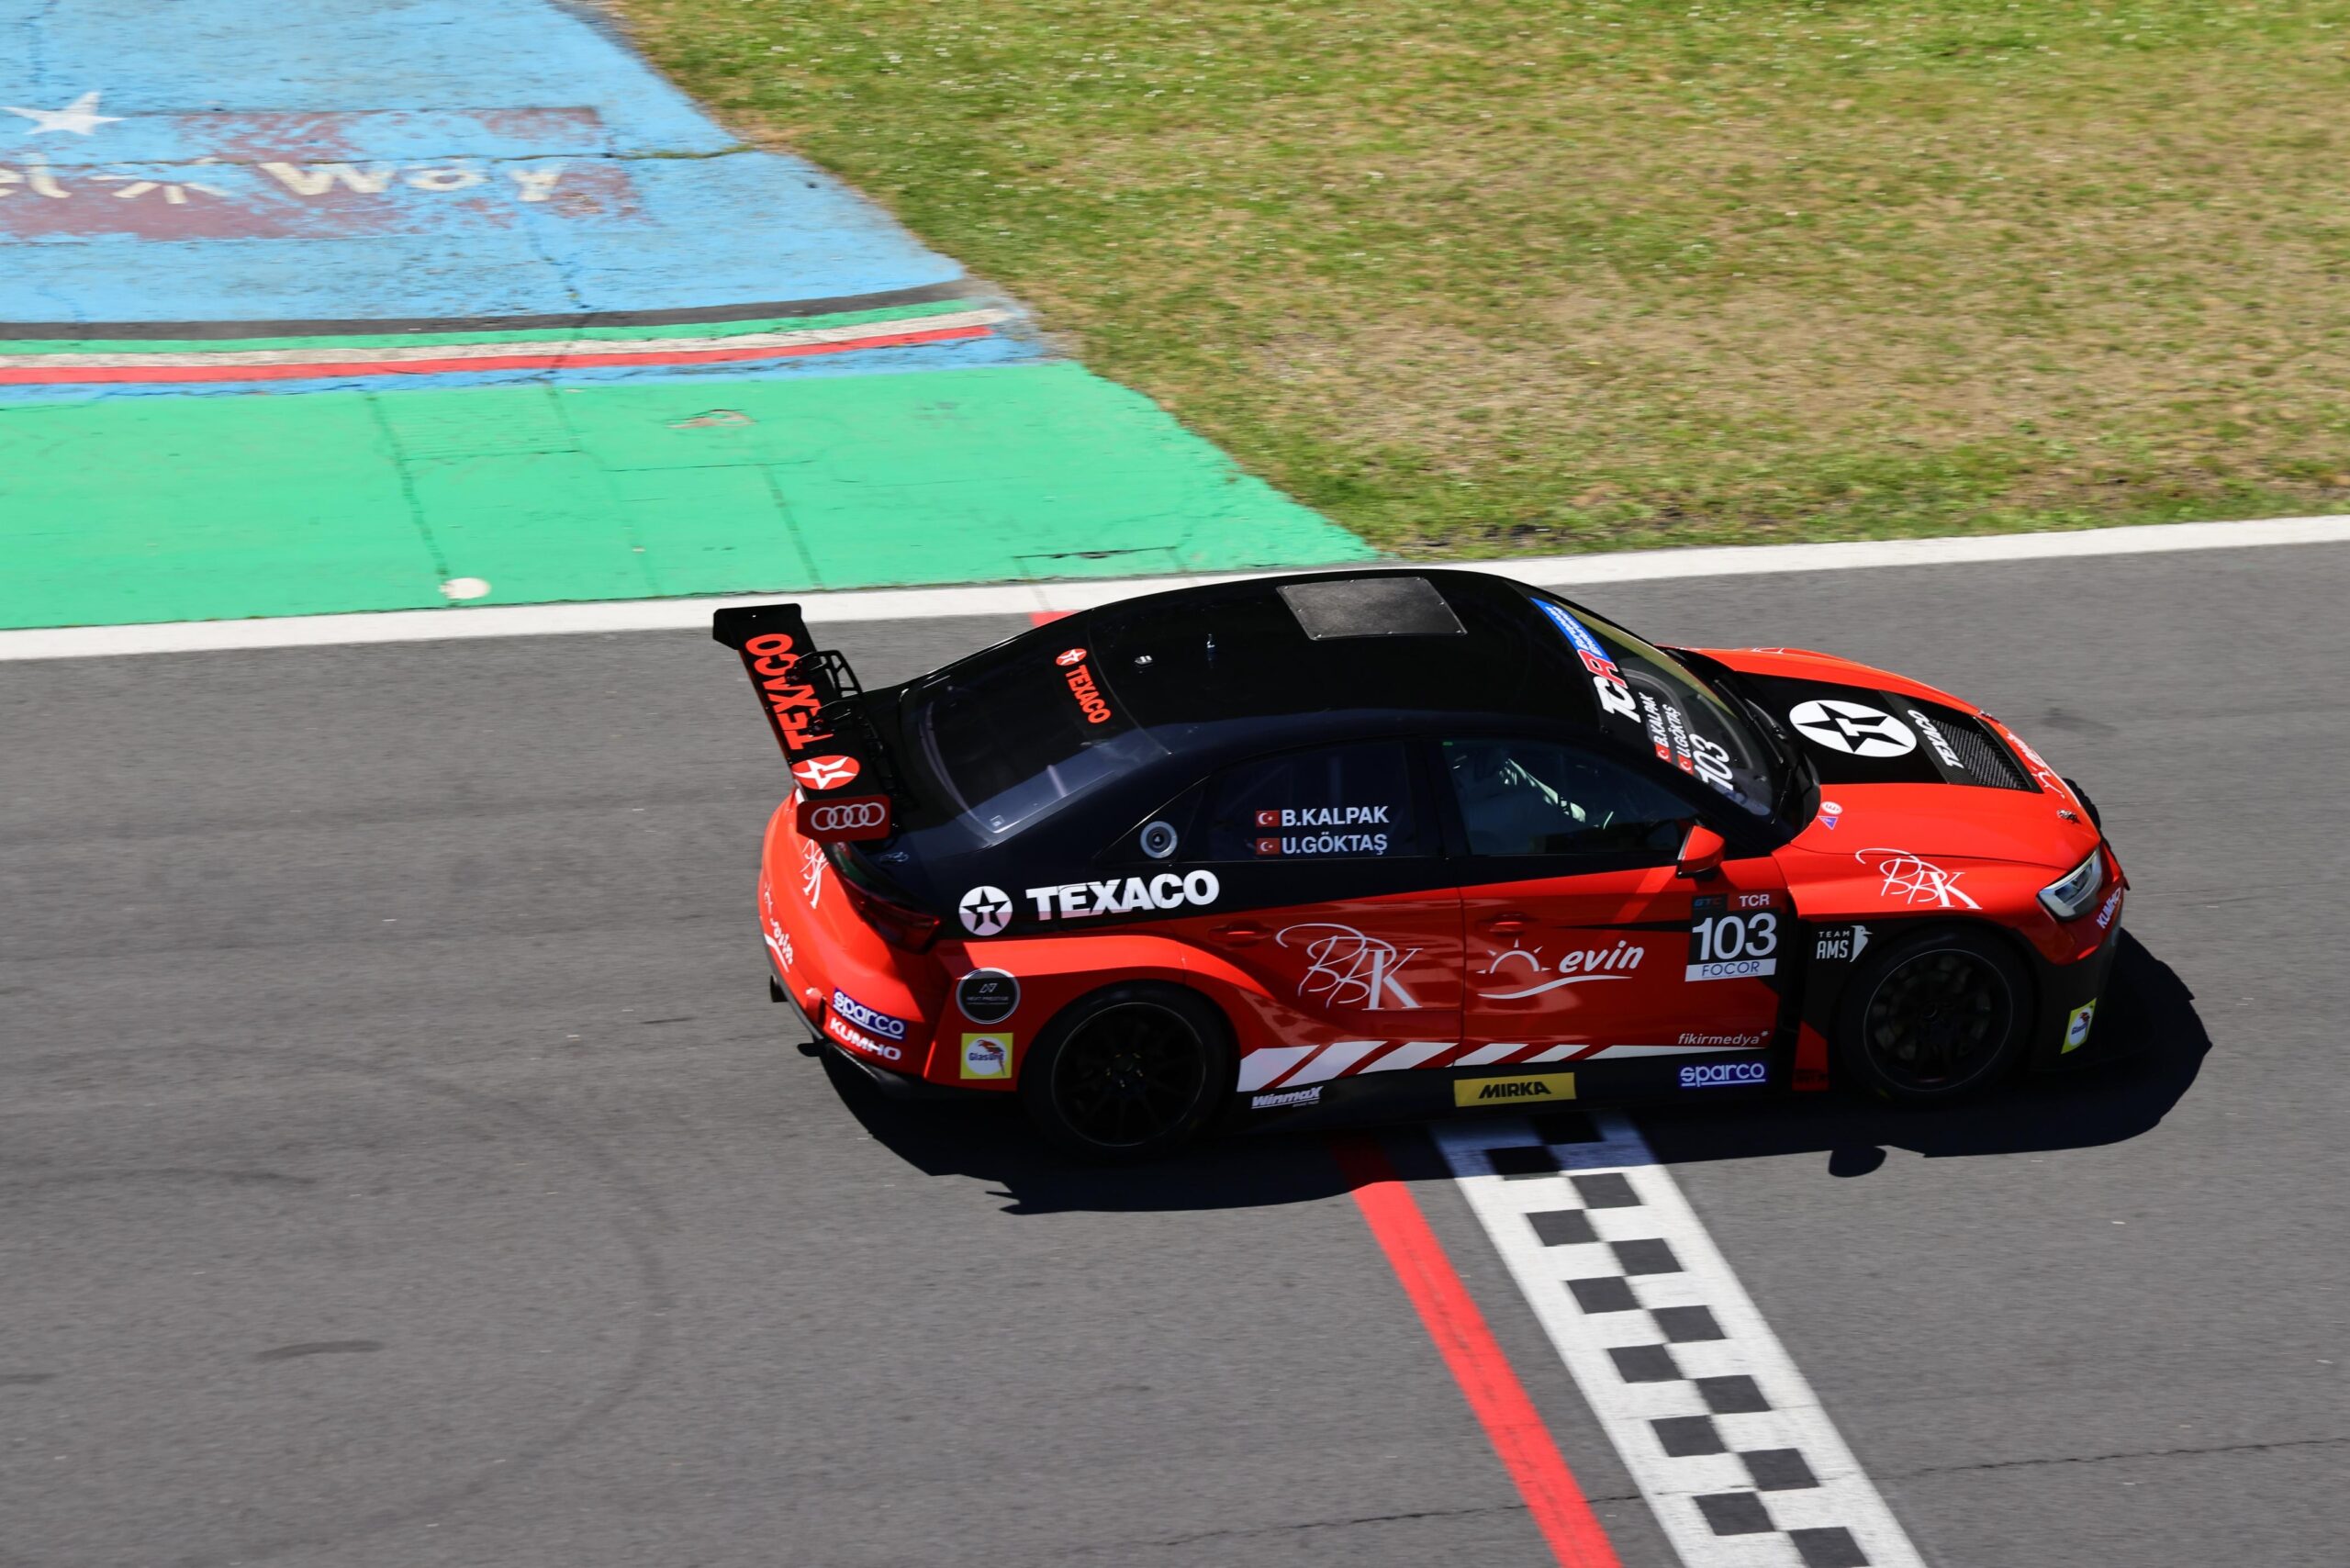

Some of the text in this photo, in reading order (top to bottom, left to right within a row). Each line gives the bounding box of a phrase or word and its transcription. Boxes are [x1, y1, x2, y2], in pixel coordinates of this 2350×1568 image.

[1065, 664, 1112, 724] TEXACO
[1577, 648, 1642, 724] TCR
[1639, 690, 1671, 749] B.KALPAK
[1907, 709, 1964, 769] TEXACO
[1689, 734, 1735, 791] 103
[1281, 805, 1390, 827] B.KALPAK
[1281, 831, 1389, 856] U.GÖKTAŞ
[1024, 869, 1221, 922] TEXACO
[1739, 893, 1771, 909] TCR
[2095, 886, 2122, 930] KUMHO
[1692, 912, 1778, 962] 103
[1815, 939, 1851, 960] AMS
[1818, 930, 1851, 938] TEAM
[1558, 939, 1645, 974] evin
[1701, 960, 1761, 979] FOCOR
[833, 990, 906, 1040] sparco
[828, 1017, 902, 1061] KUMHO
[1677, 1032, 1760, 1047] fikirmedya
[1478, 1081, 1551, 1099] MIRKA
[1680, 1062, 1766, 1087] sparco
